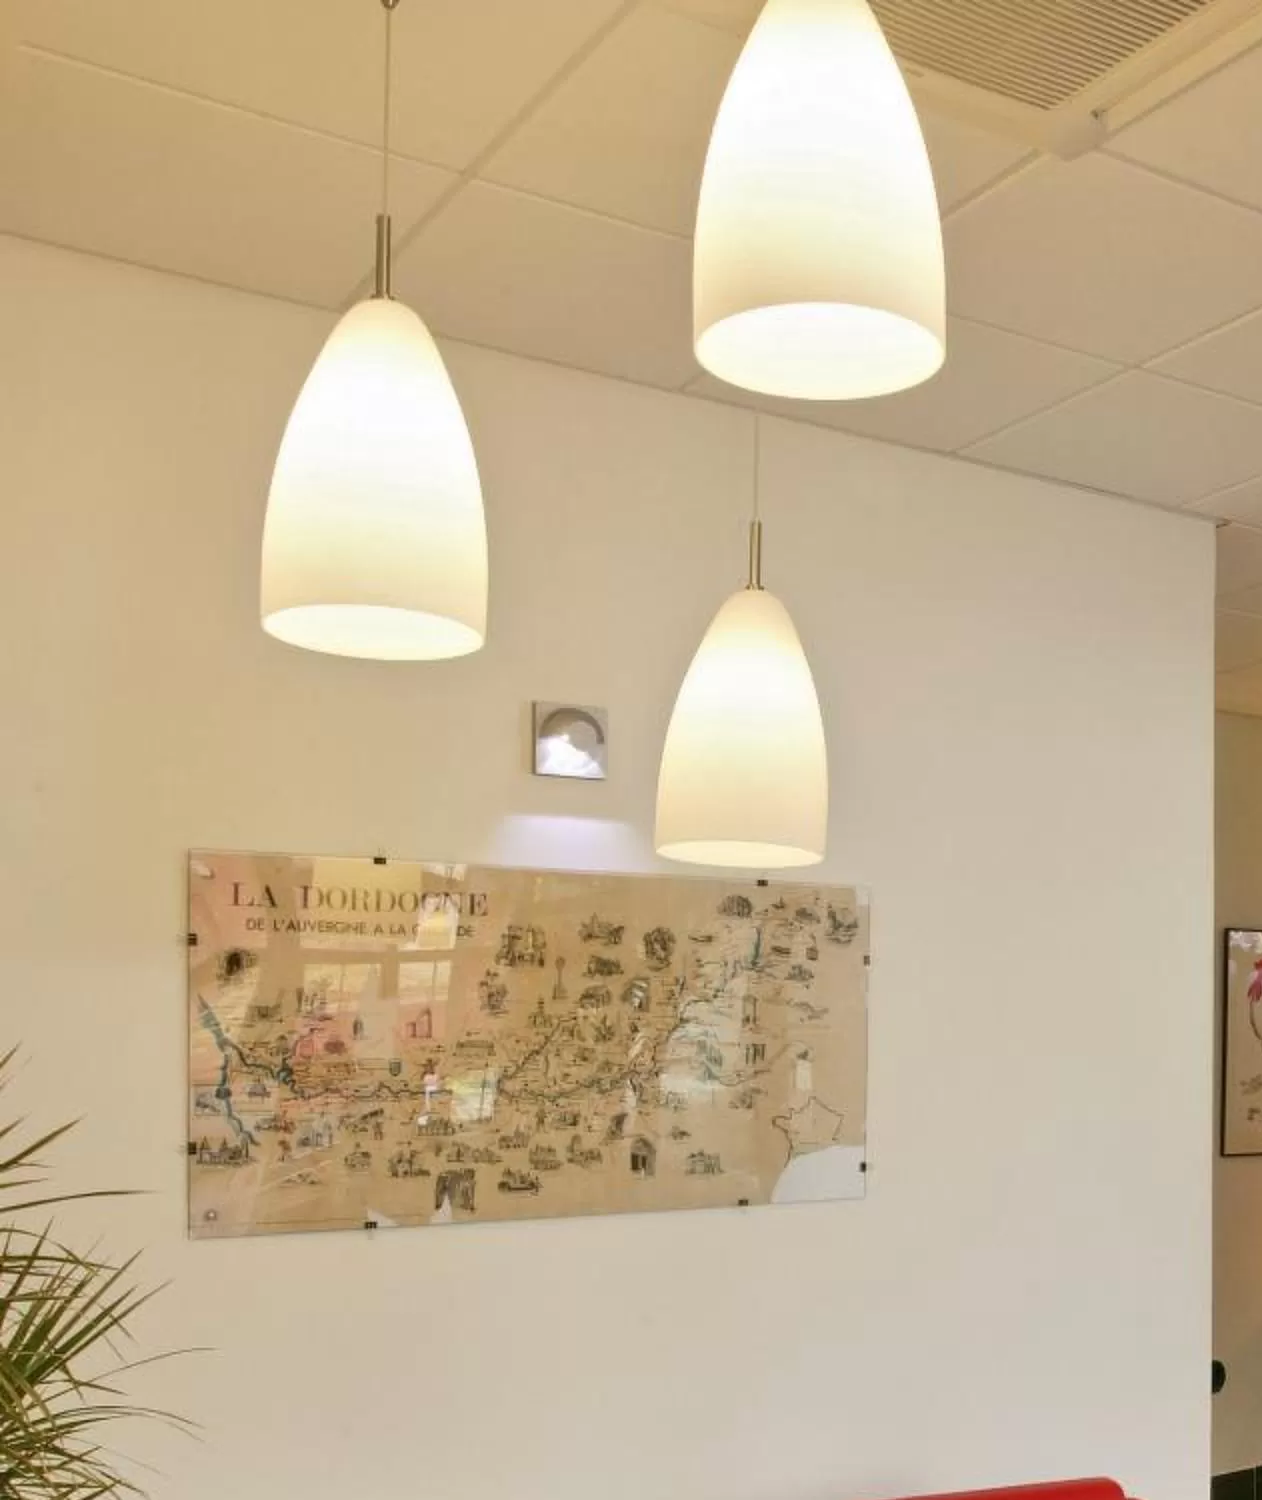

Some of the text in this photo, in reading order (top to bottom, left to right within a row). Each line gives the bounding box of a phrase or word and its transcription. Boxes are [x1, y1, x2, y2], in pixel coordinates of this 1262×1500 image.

[230, 881, 489, 917] LA DORDOGNE
[246, 917, 266, 932] DE
[389, 923, 407, 937] LA
